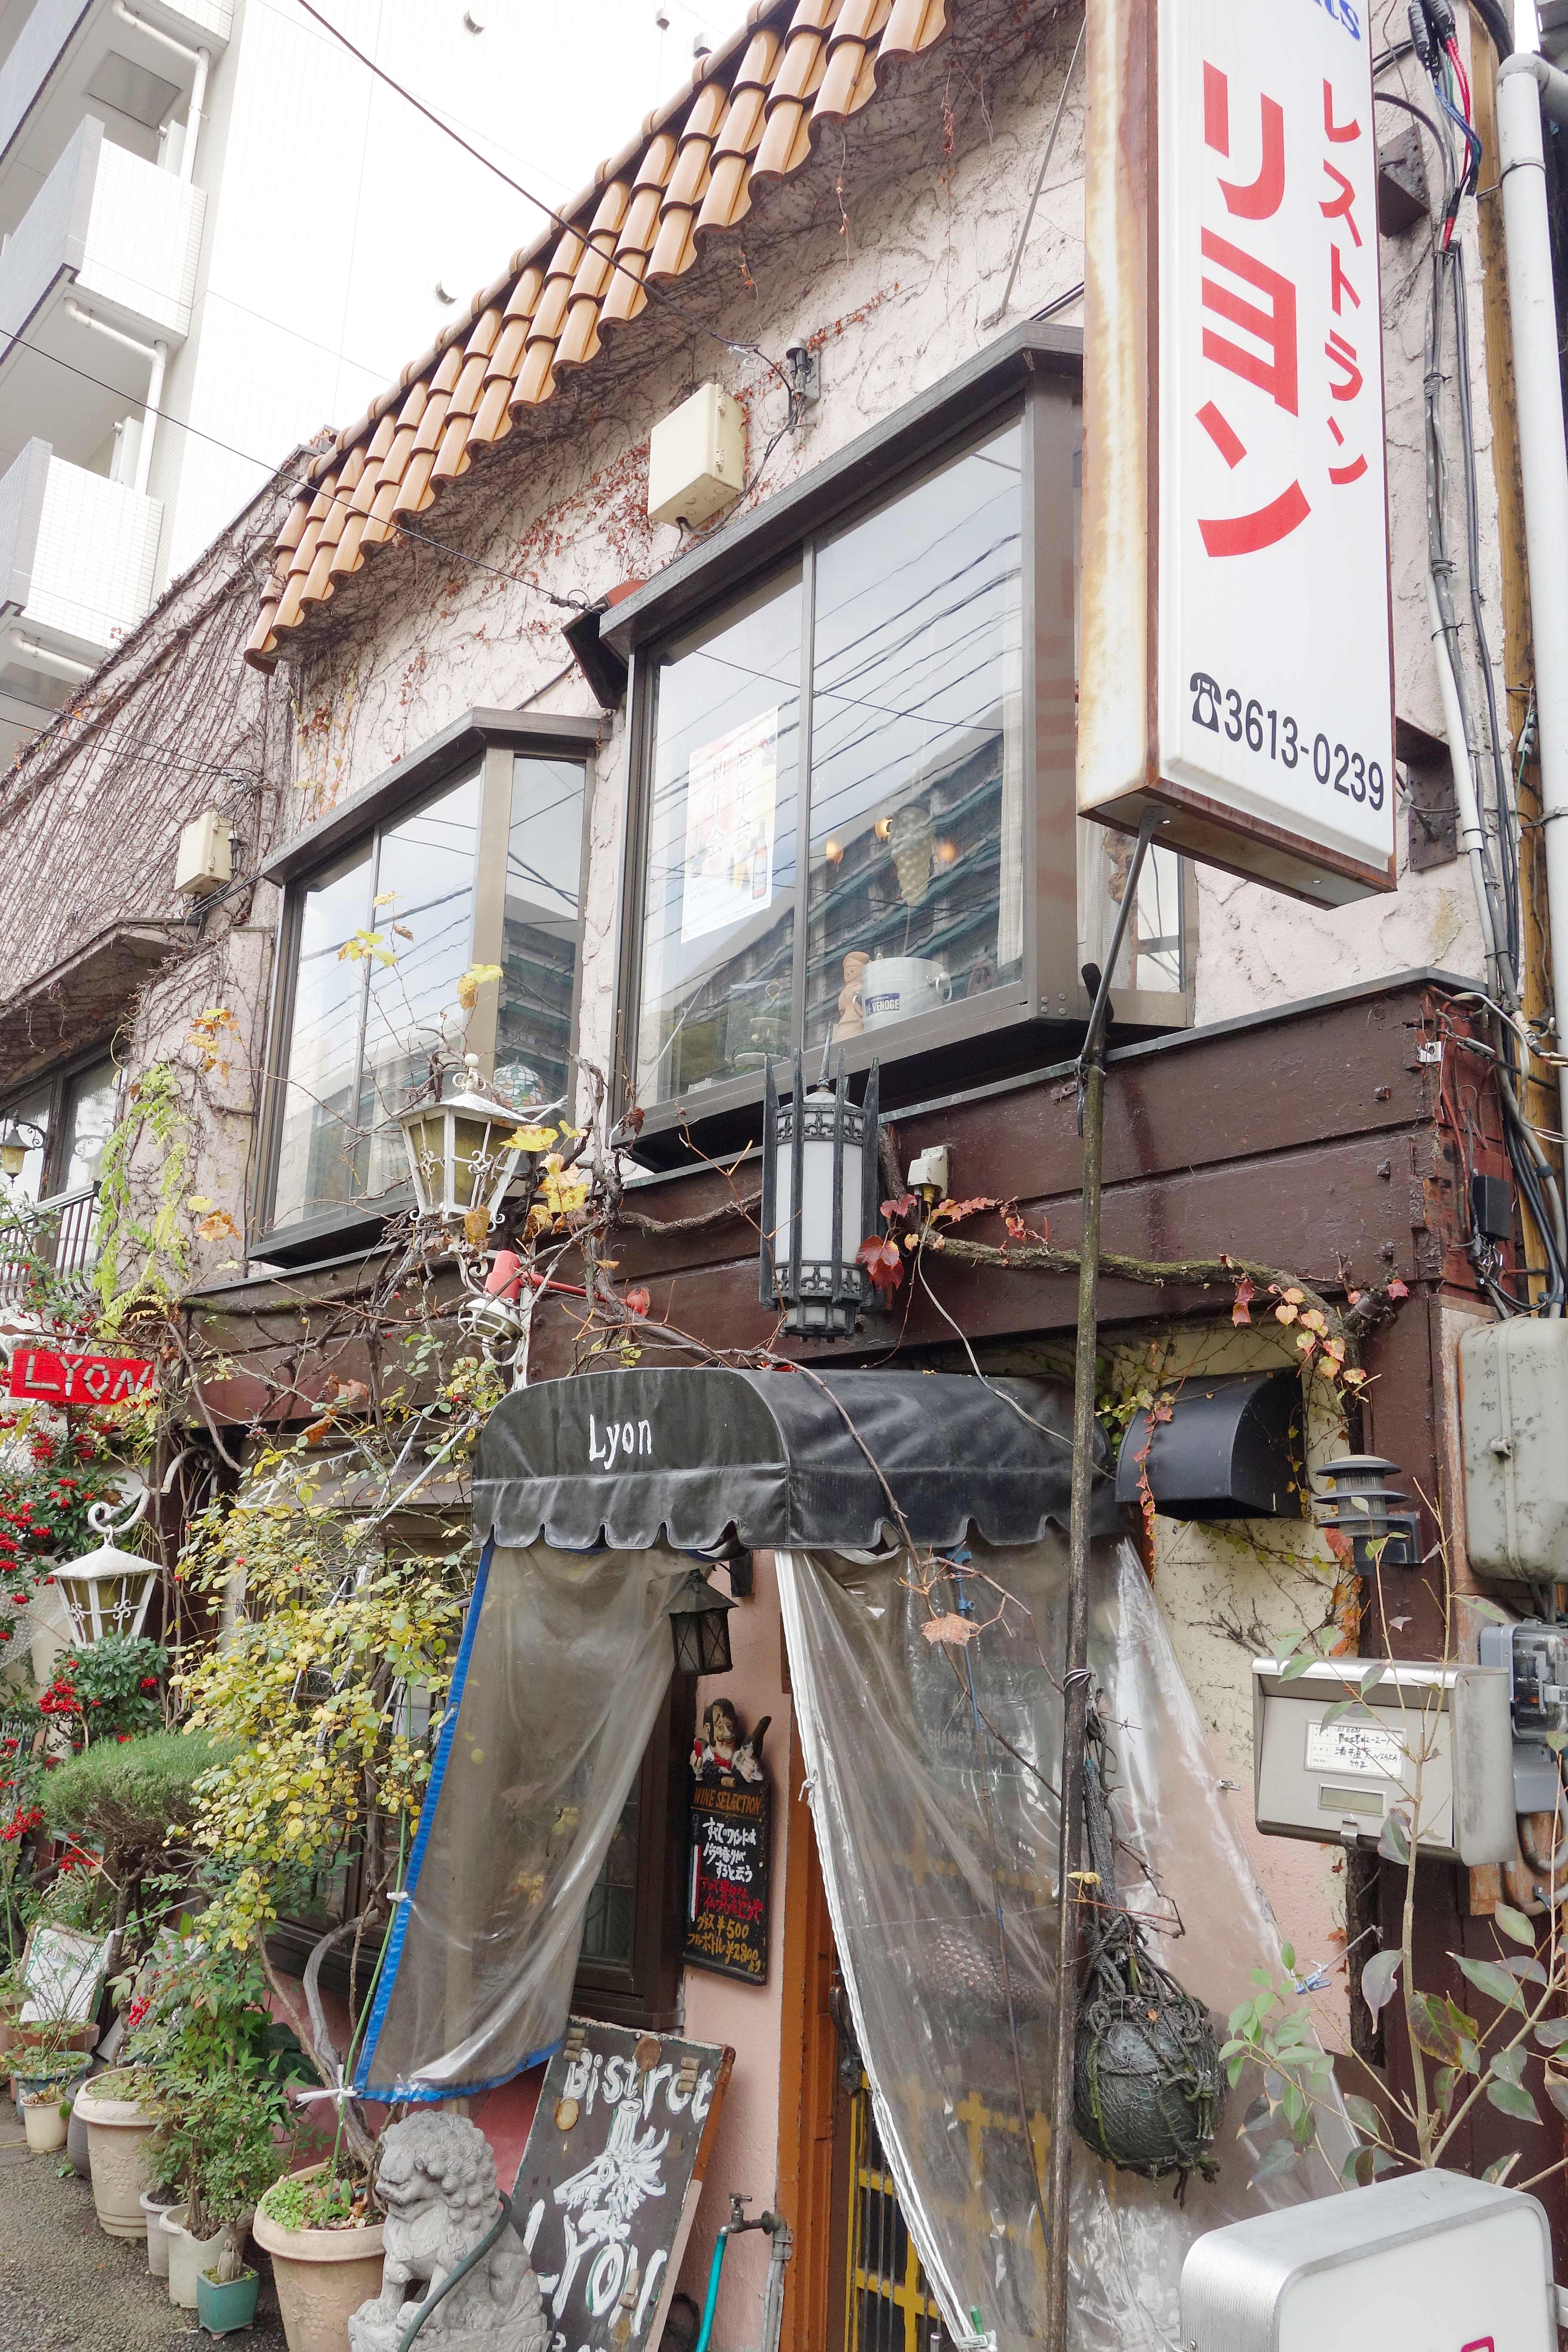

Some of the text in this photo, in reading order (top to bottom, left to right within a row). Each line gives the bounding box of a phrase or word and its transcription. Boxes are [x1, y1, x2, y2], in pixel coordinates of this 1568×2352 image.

[1194, 59, 1311, 557] リヨン
[1318, 77, 1368, 485] レストラン
[1225, 688, 1384, 811] 3613-0239
[707, 754, 728, 858] 新年会
[872, 999, 899, 1012] VENOGE
[589, 1414, 652, 1470] Lyon
[694, 1787, 762, 1815] WINE SELECTION
[717, 1915, 749, 1940] ¥500
